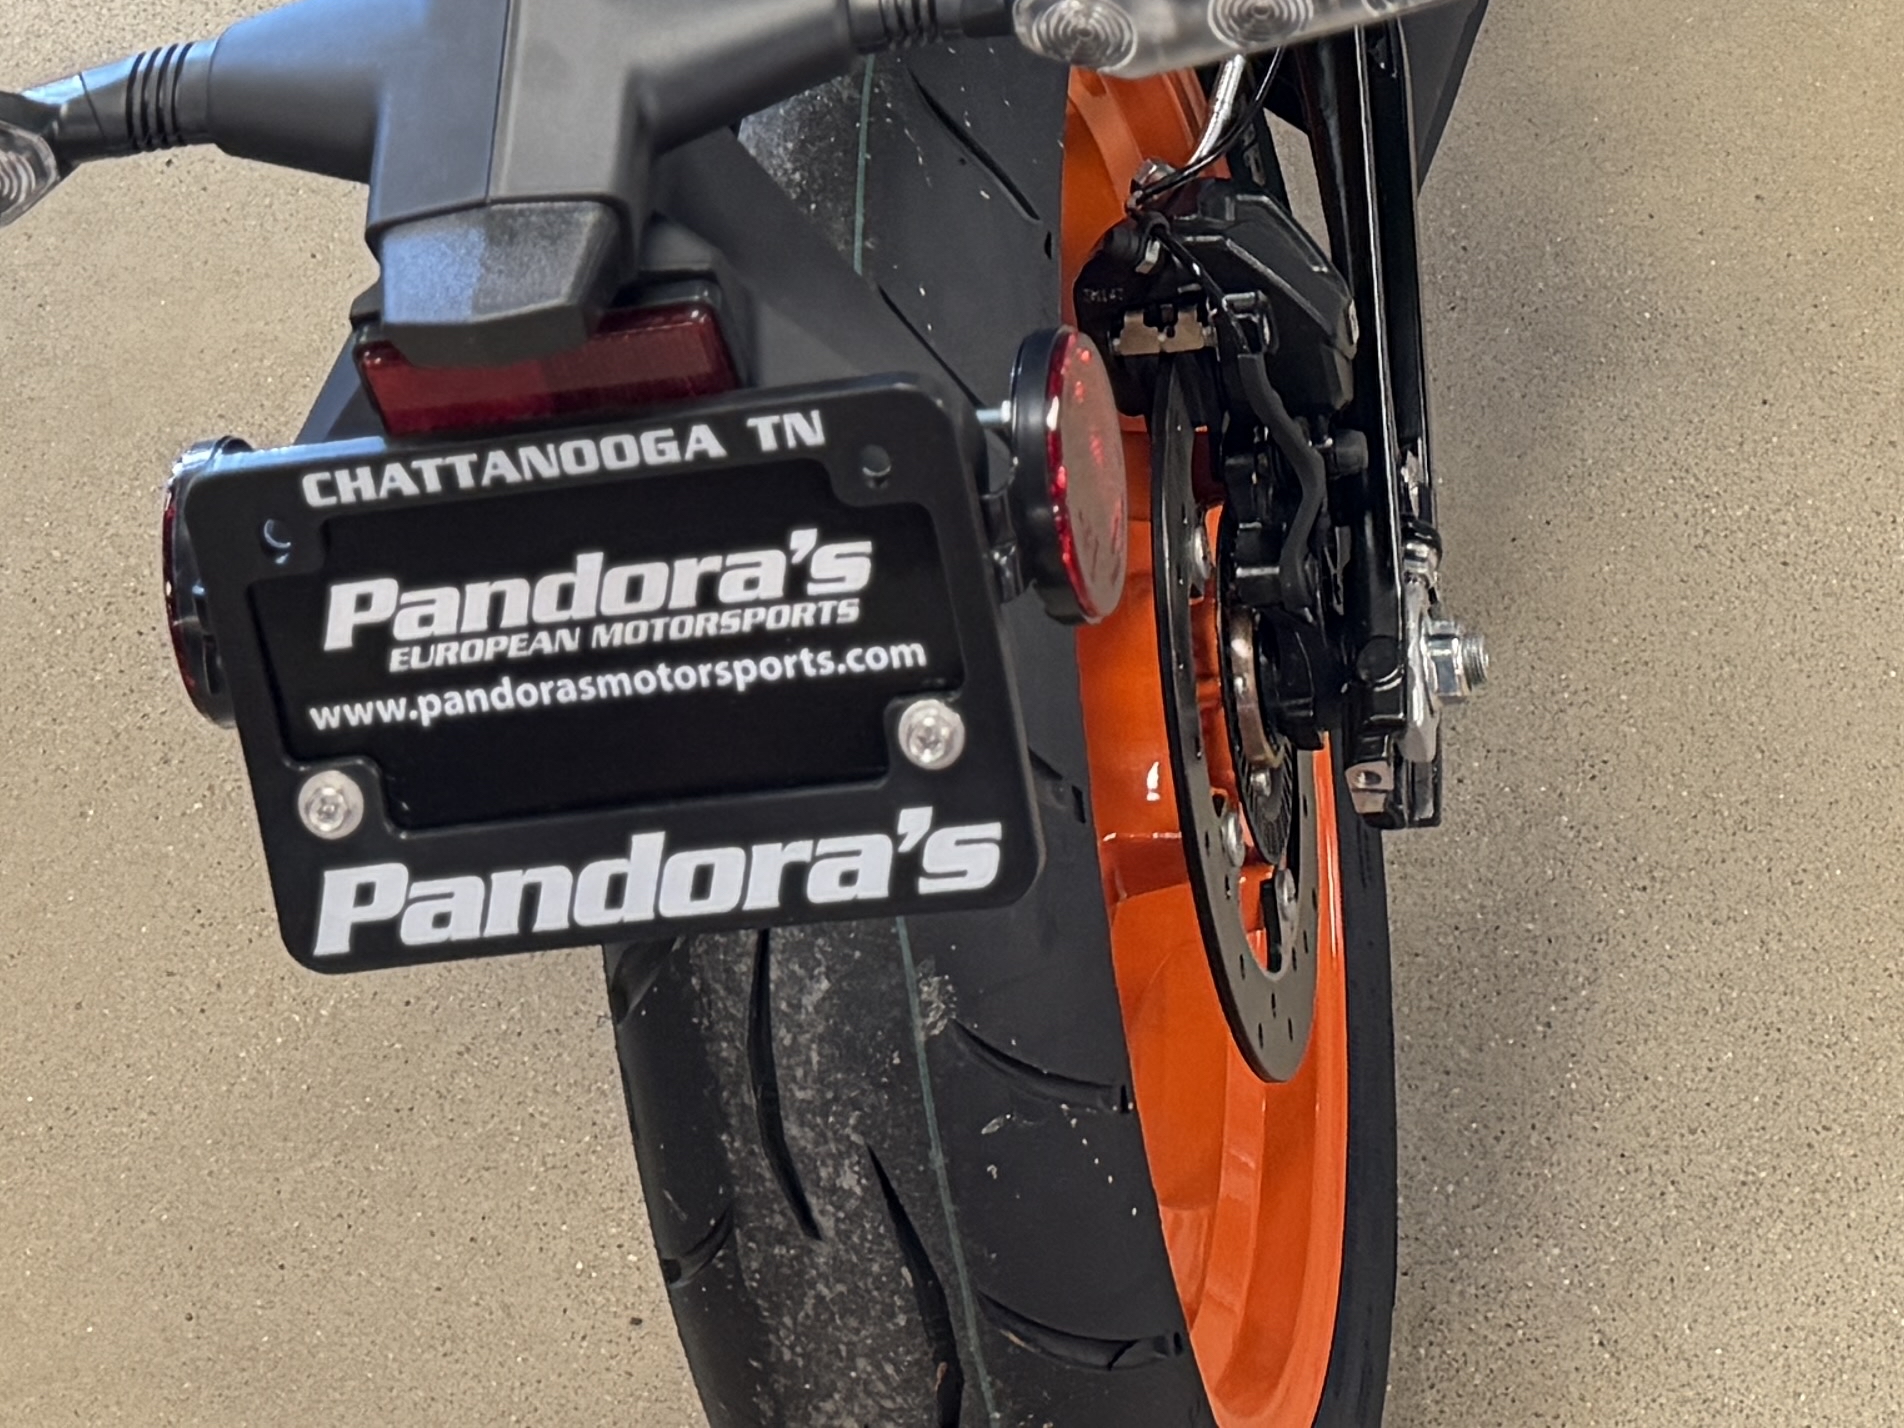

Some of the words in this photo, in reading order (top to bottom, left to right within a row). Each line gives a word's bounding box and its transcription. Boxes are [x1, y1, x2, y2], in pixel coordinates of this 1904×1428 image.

[302, 424, 728, 509] CHATTANOOGA
[746, 409, 828, 453] TN
[322, 528, 873, 652] Pandora's
[389, 627, 582, 674] EUROPEAN
[590, 598, 862, 647] MOTORSPORTS
[308, 637, 928, 732] www.pandorasmotorsports.com
[313, 806, 1004, 959] Pandora's
